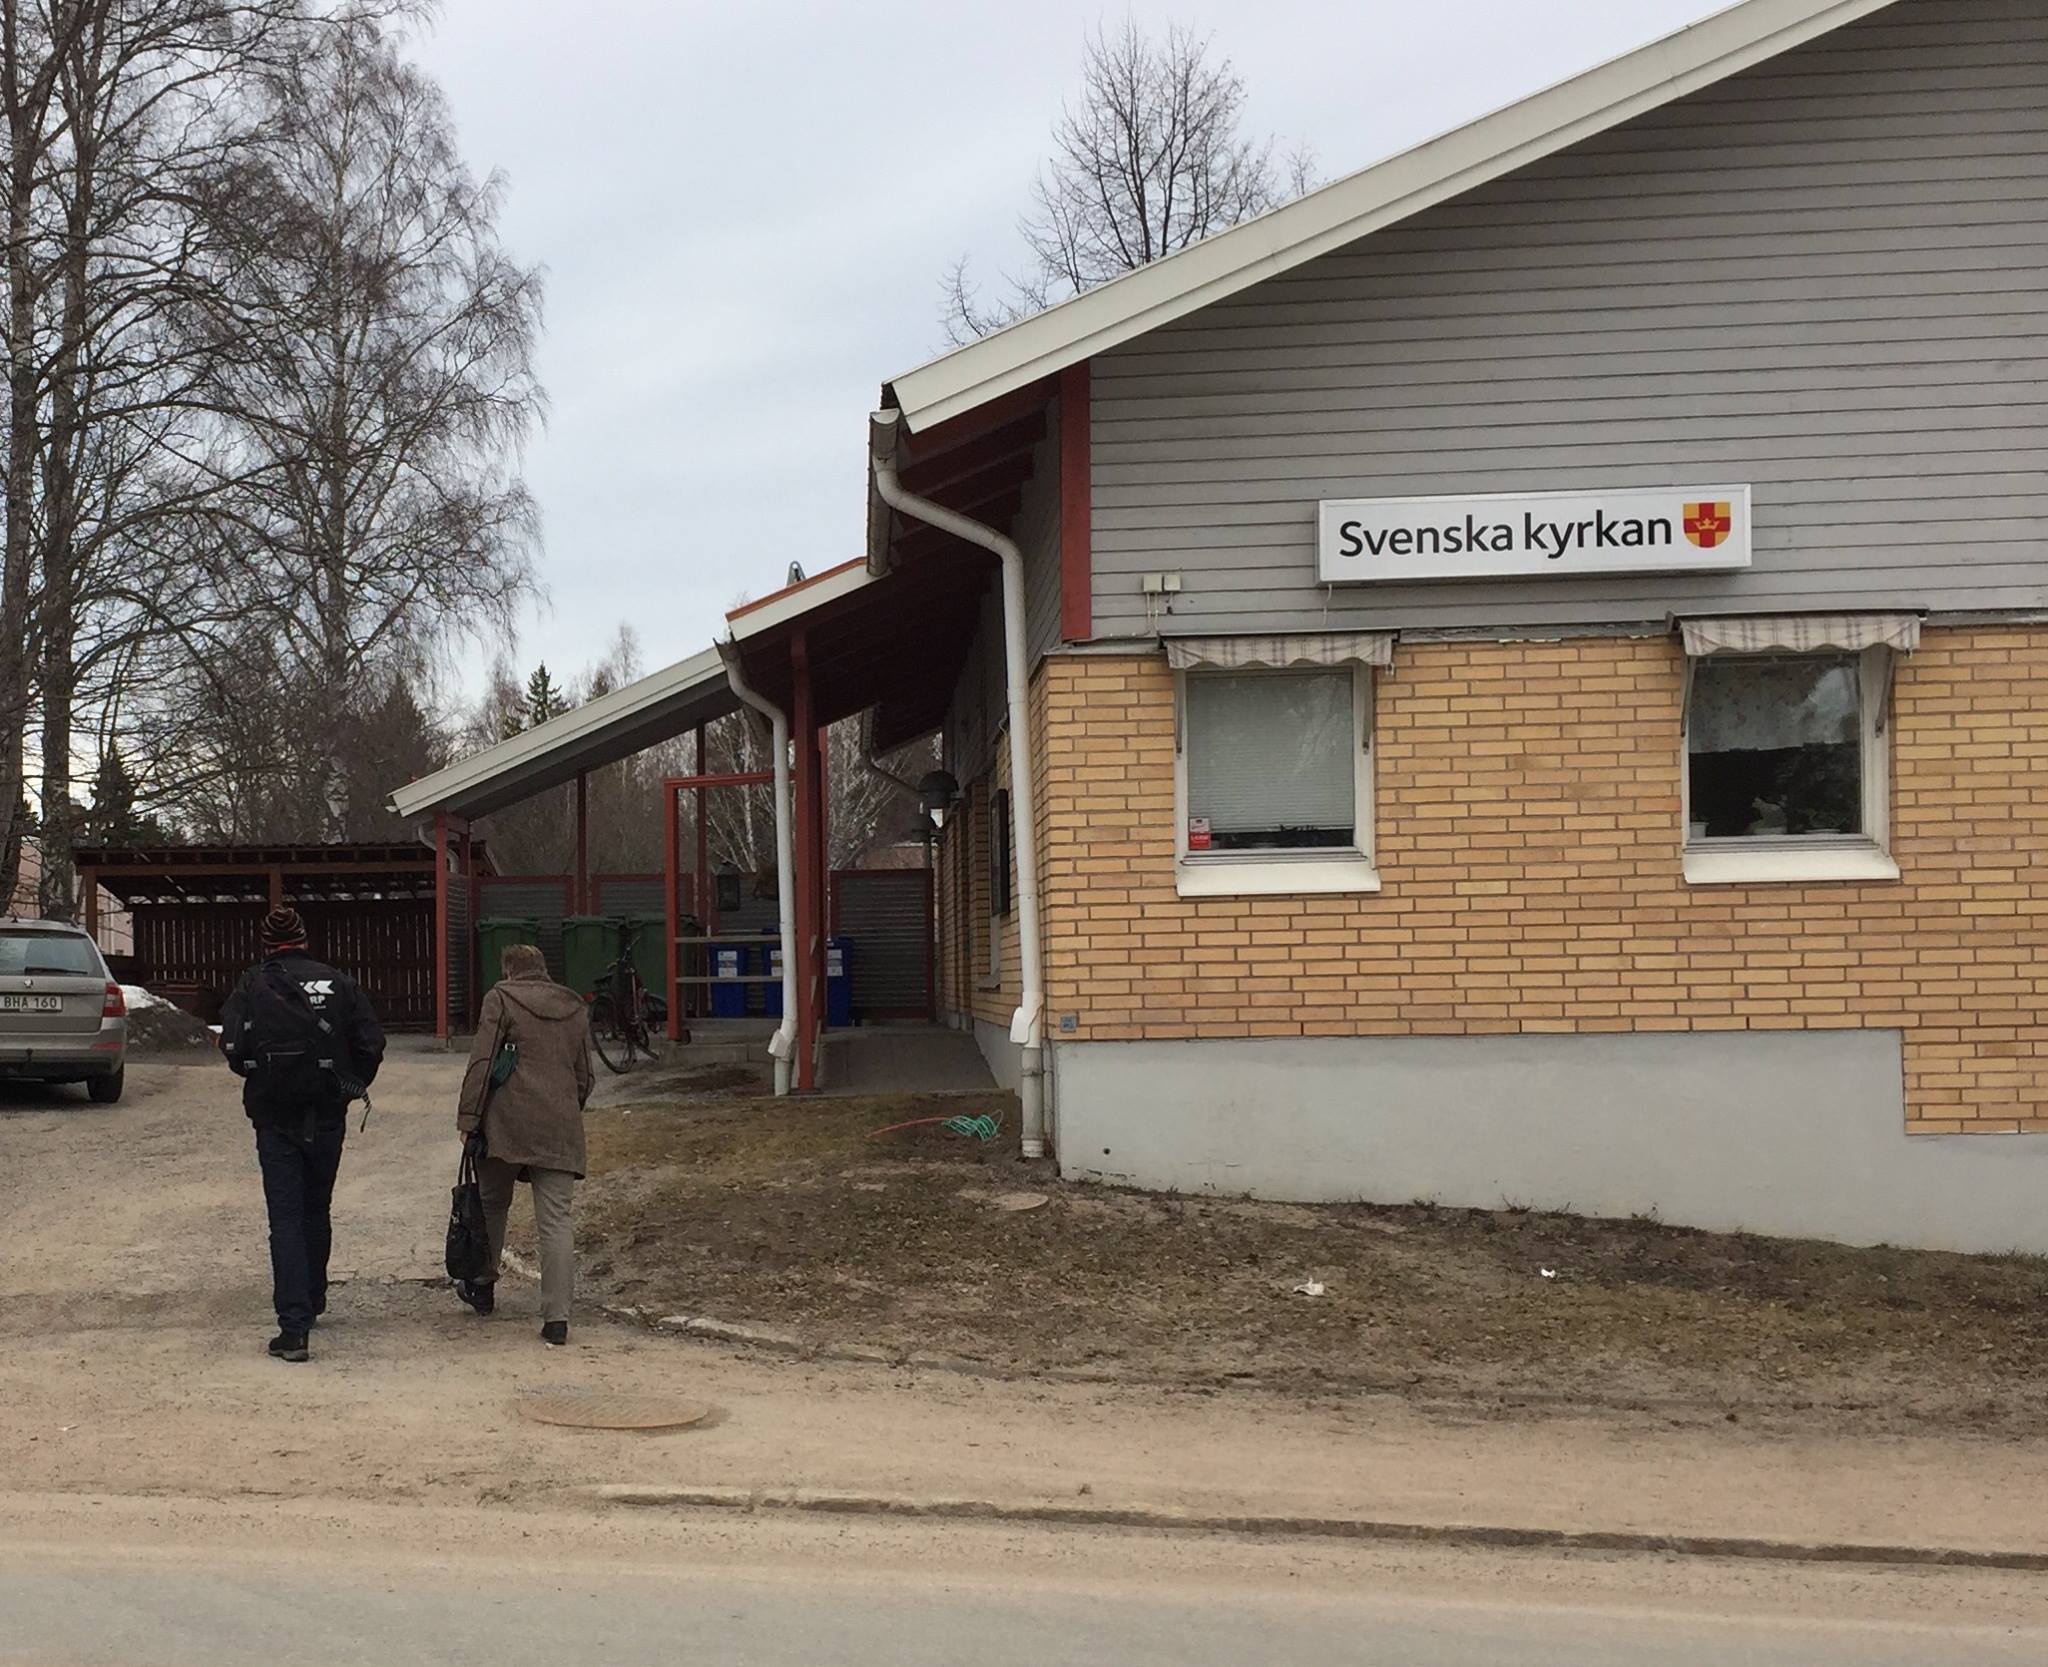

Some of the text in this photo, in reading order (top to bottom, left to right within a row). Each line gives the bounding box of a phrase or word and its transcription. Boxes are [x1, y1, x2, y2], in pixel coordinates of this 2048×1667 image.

[1339, 510, 1672, 559] Svenska kyrkan
[4, 997, 57, 1008] BHA 160
